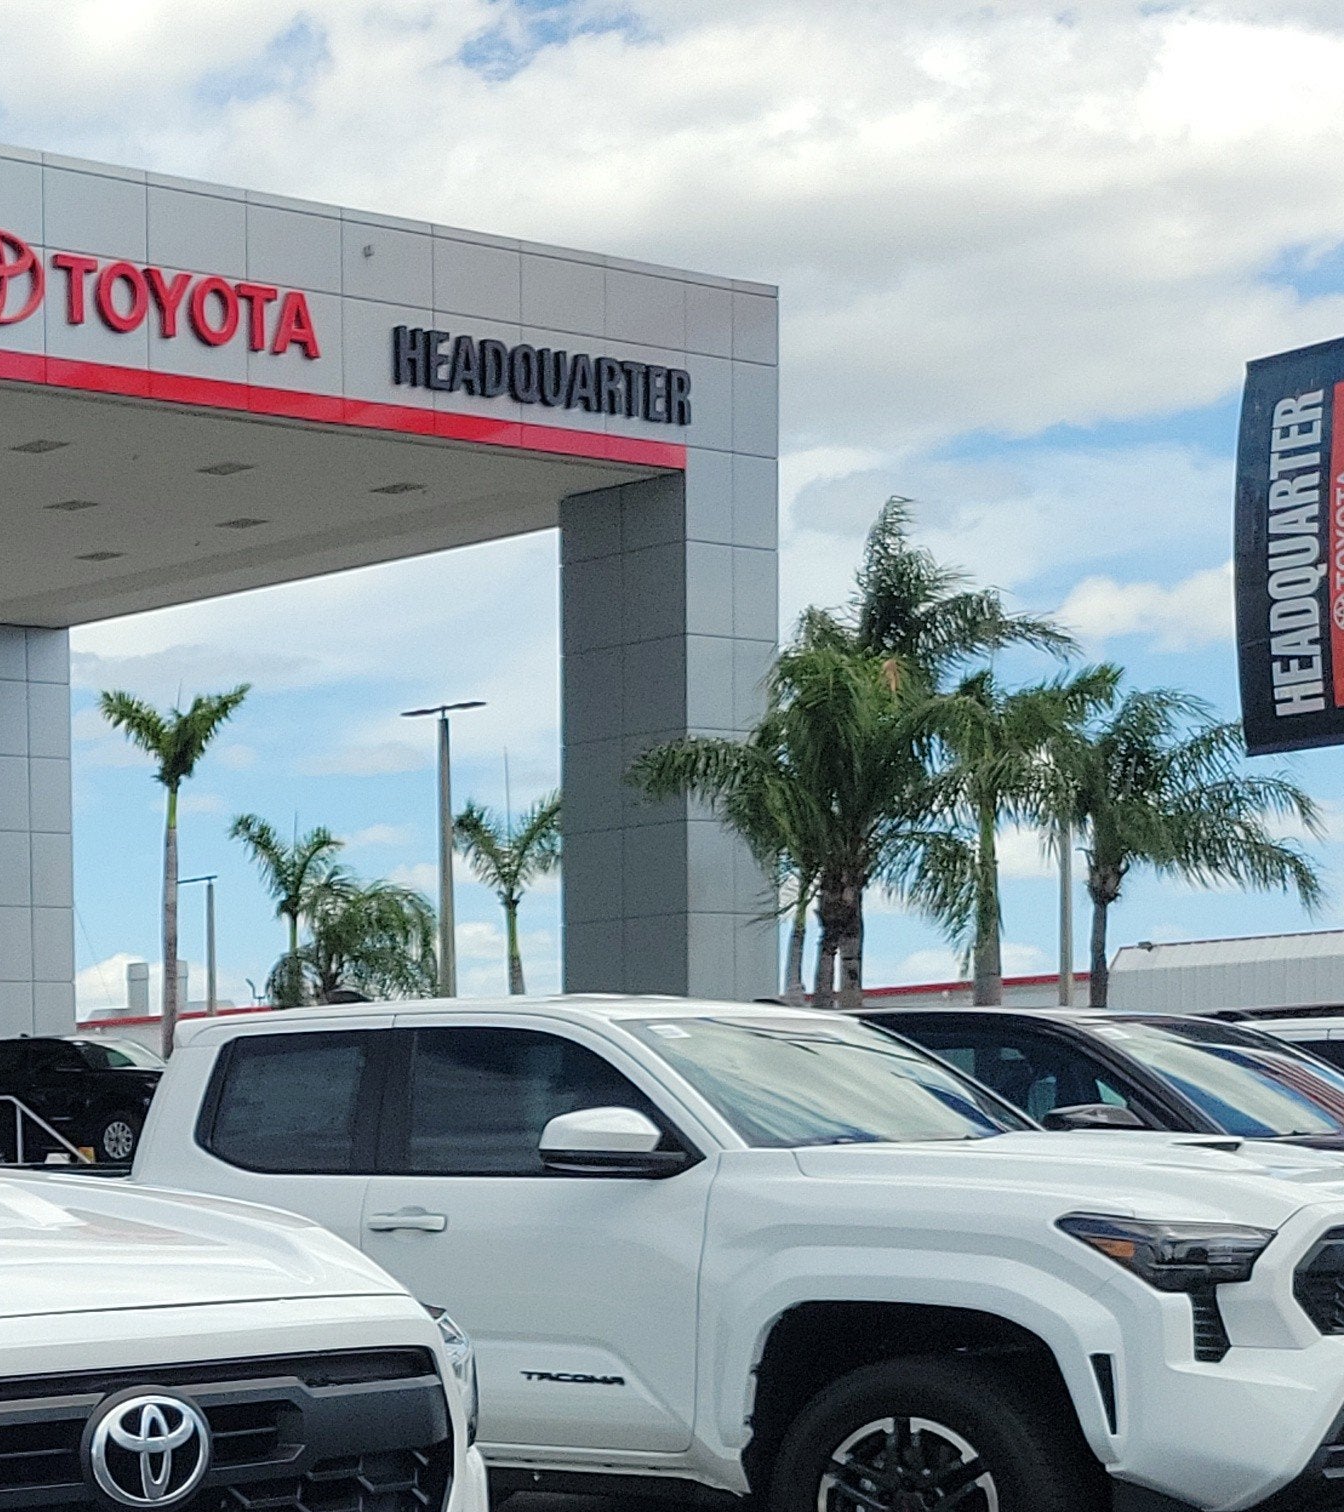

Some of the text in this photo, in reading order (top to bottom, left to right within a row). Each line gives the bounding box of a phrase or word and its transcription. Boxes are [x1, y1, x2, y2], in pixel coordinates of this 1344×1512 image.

[53, 254, 320, 359] TOYOTA
[392, 326, 692, 426] HEADQUARTER
[1268, 389, 1327, 716] HEADQUARTER
